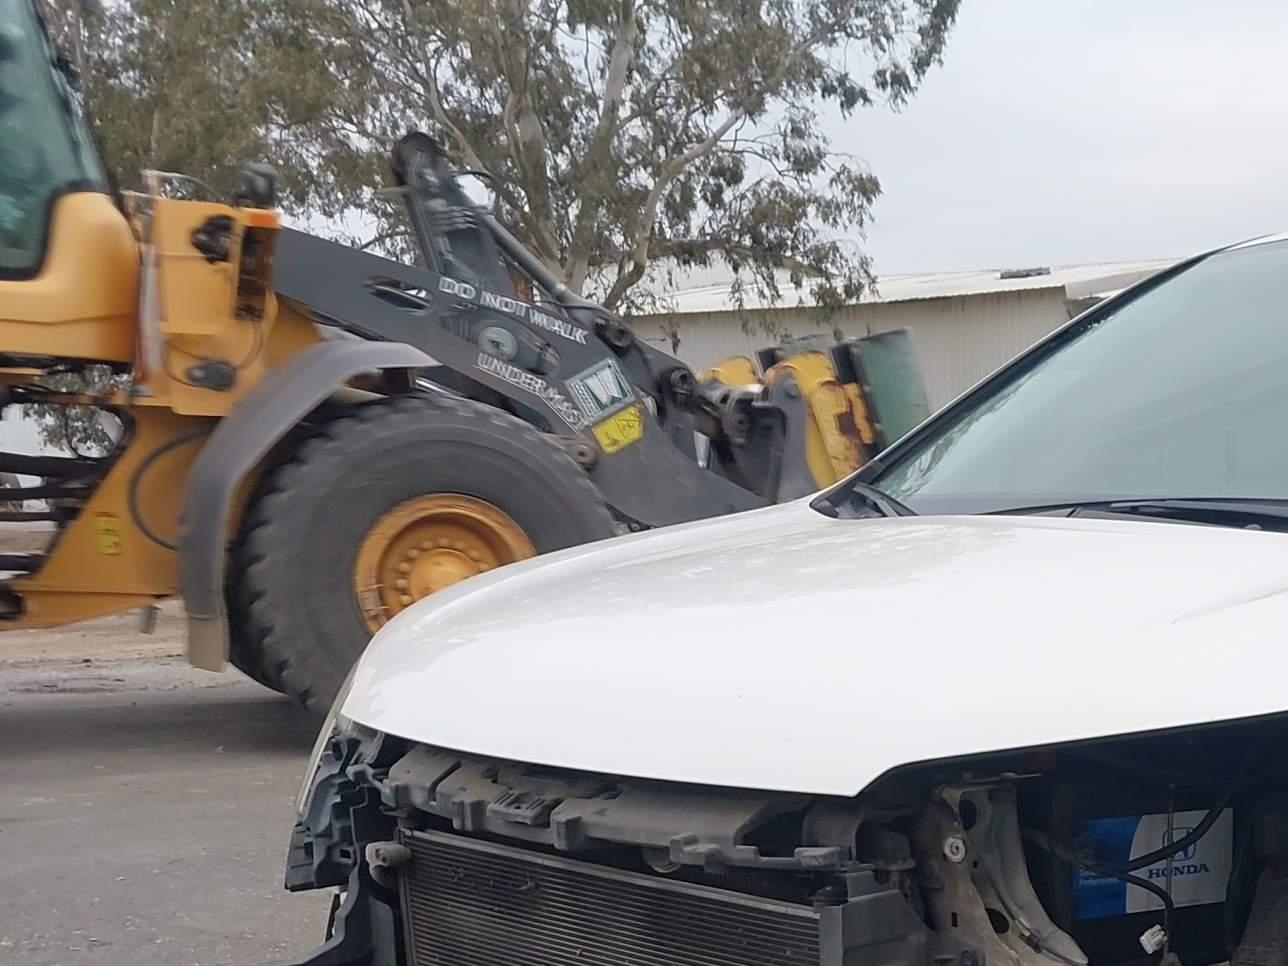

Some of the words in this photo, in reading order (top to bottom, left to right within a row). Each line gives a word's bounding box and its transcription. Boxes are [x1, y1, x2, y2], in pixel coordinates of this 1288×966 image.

[439, 276, 476, 299] DO
[481, 290, 529, 318] NOT
[528, 309, 589, 345] WALK
[476, 353, 547, 394] UNDER
[1148, 863, 1210, 879] HONDA
